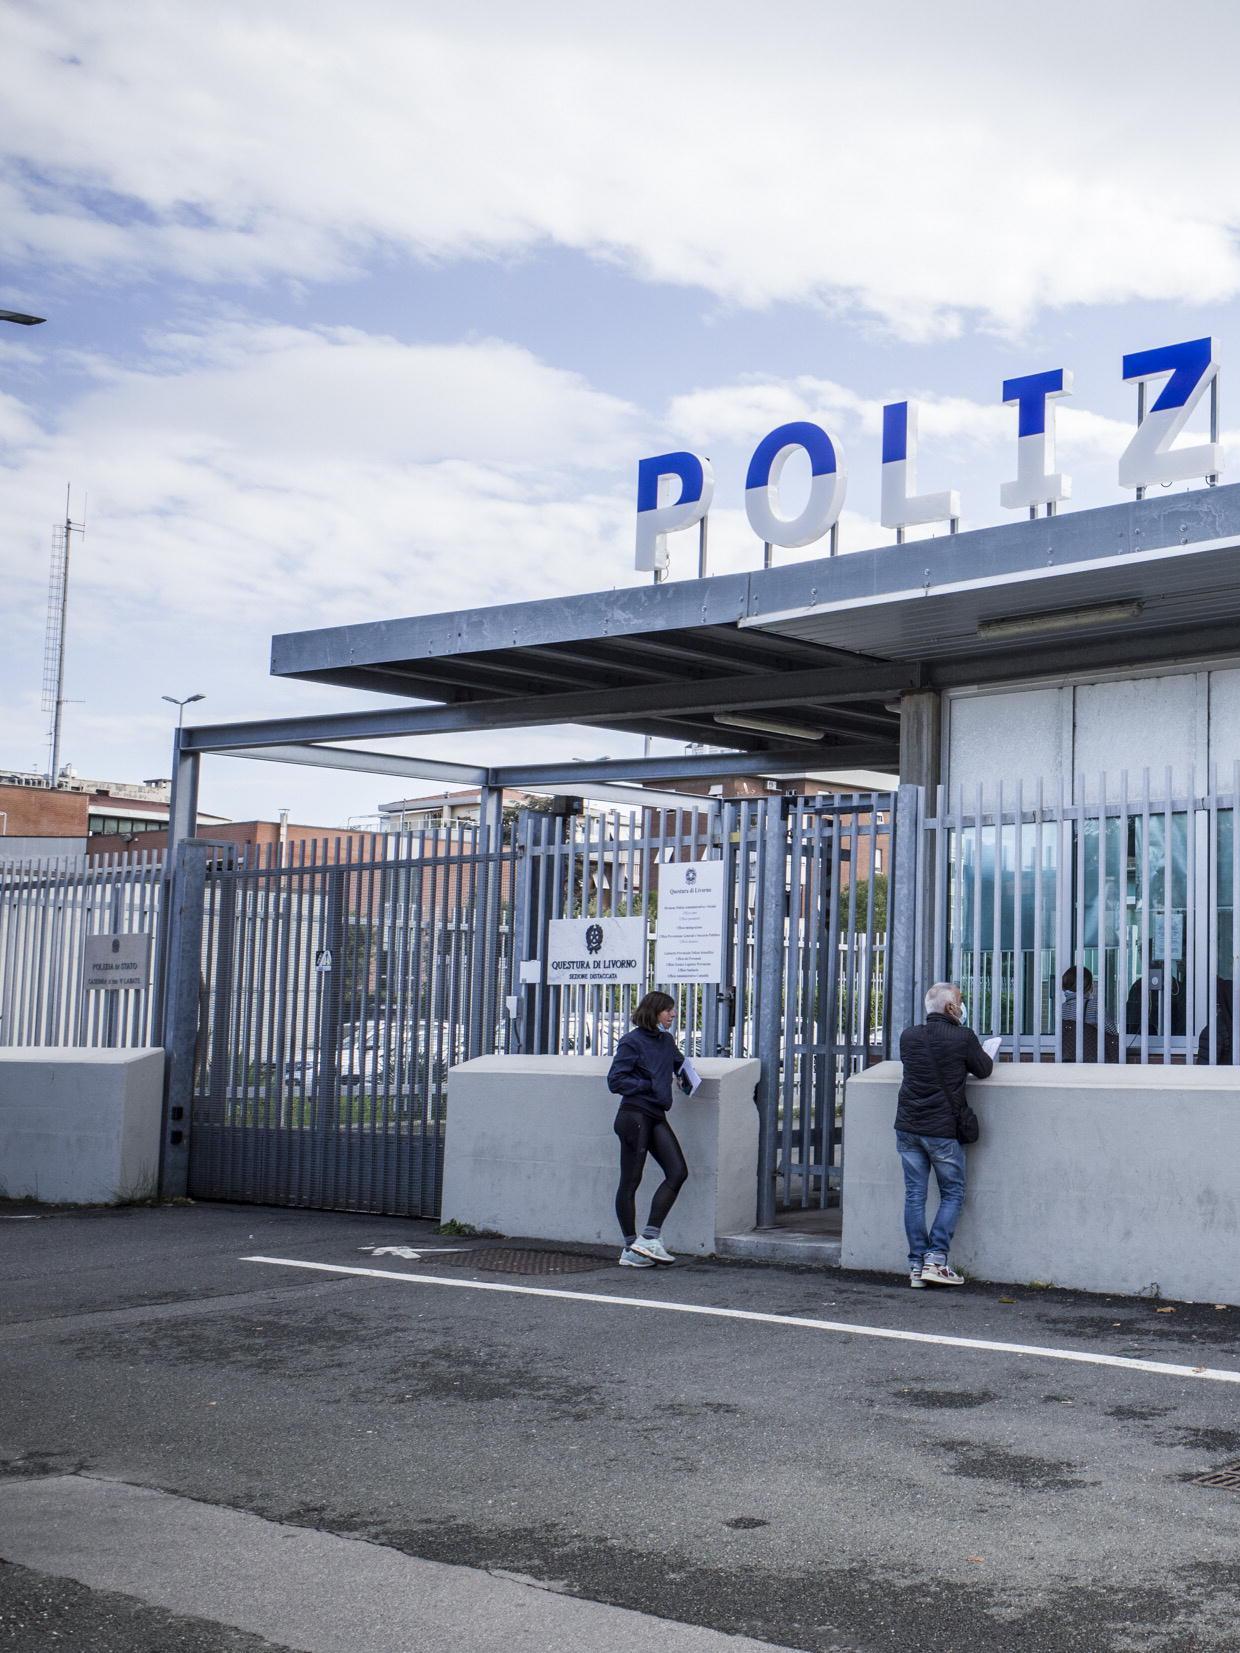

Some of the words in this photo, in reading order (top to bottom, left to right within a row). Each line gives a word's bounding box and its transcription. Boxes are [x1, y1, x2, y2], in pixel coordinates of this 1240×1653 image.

[552, 960, 591, 970] QUESTURA
[593, 960, 601, 969] DI
[603, 959, 637, 969] LIVORNO
